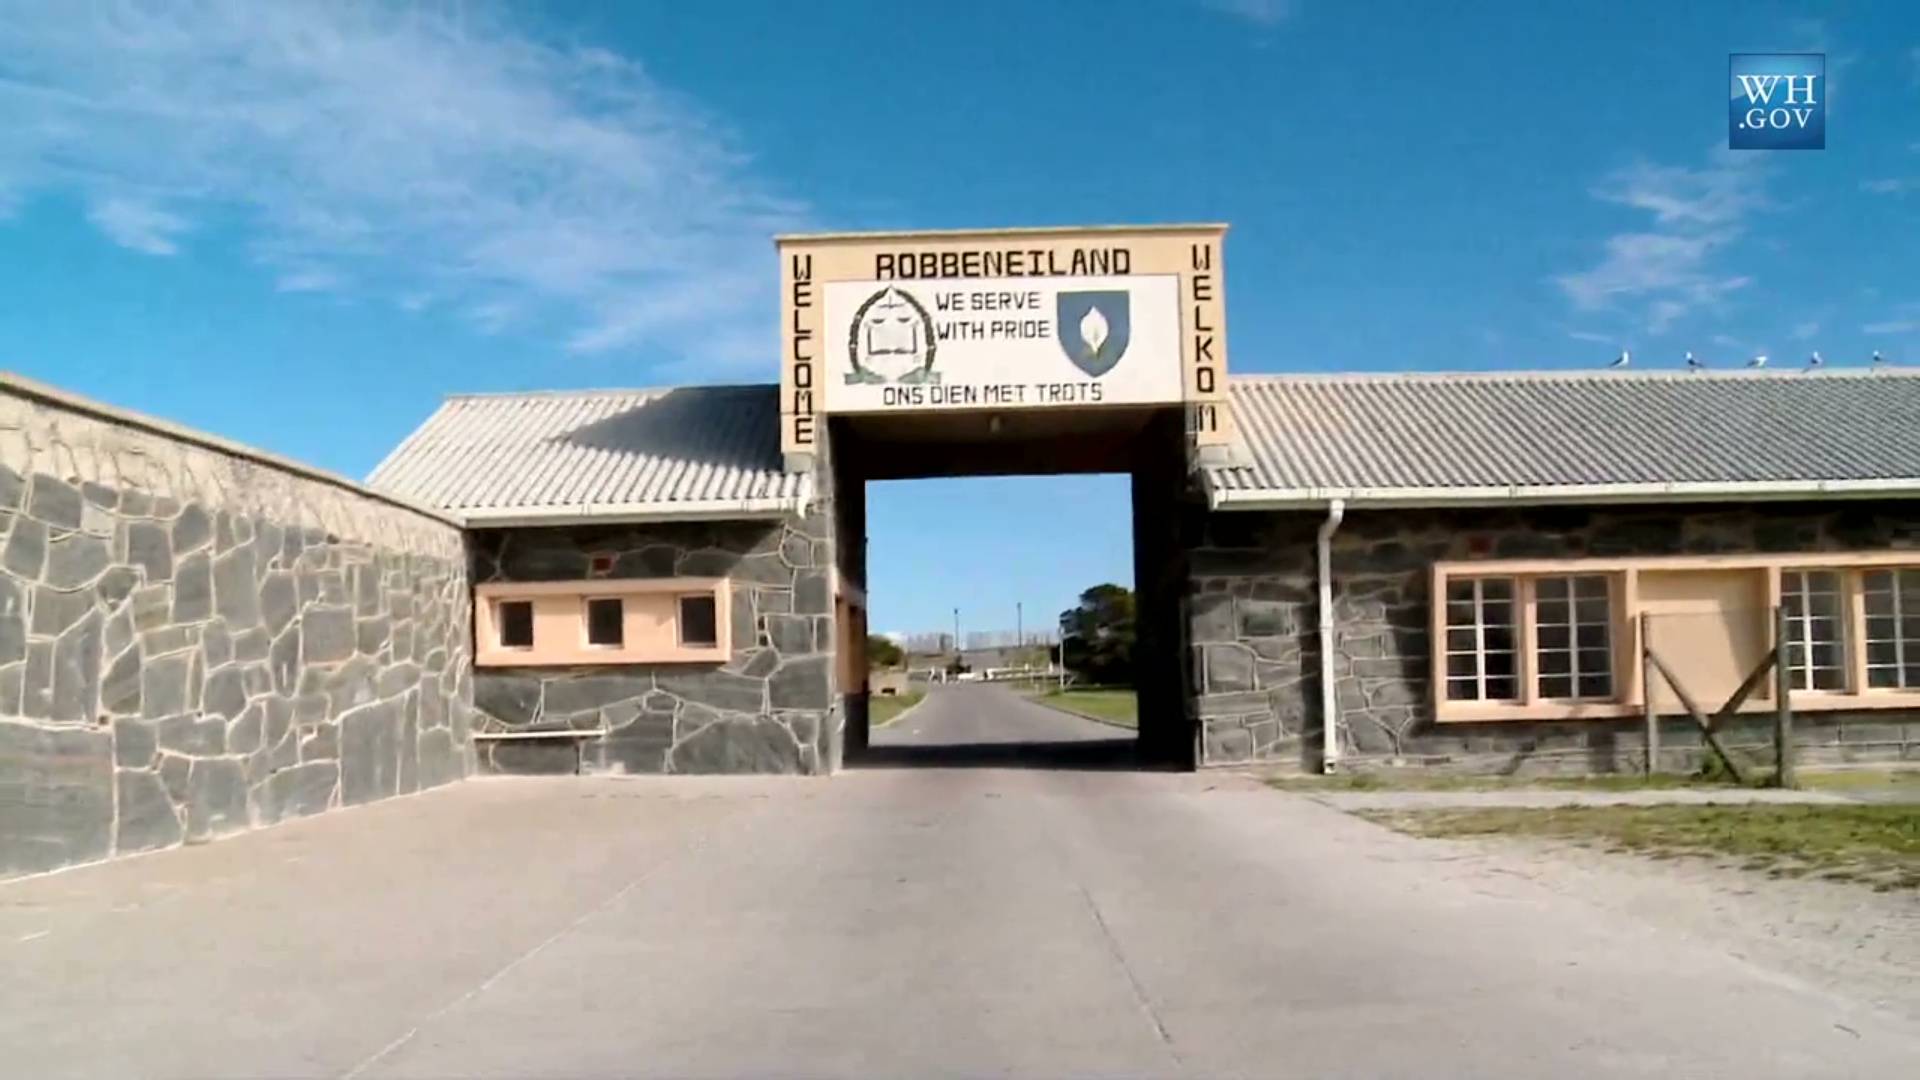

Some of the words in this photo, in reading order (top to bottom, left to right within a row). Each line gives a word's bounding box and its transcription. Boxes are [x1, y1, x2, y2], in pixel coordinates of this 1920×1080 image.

[876, 248, 1131, 280] ROBBENEILAND
[935, 292, 966, 312] WE
[971, 291, 1042, 311] SERVE
[936, 320, 984, 340] WITH
[990, 319, 1051, 339] PRIDE
[1191, 244, 1217, 432] WELKOM
[792, 254, 813, 444] WELCOME
[883, 386, 924, 406] ONS
[930, 384, 977, 405] DIEN
[984, 383, 1025, 403] MET
[1036, 382, 1102, 402] TROTS
